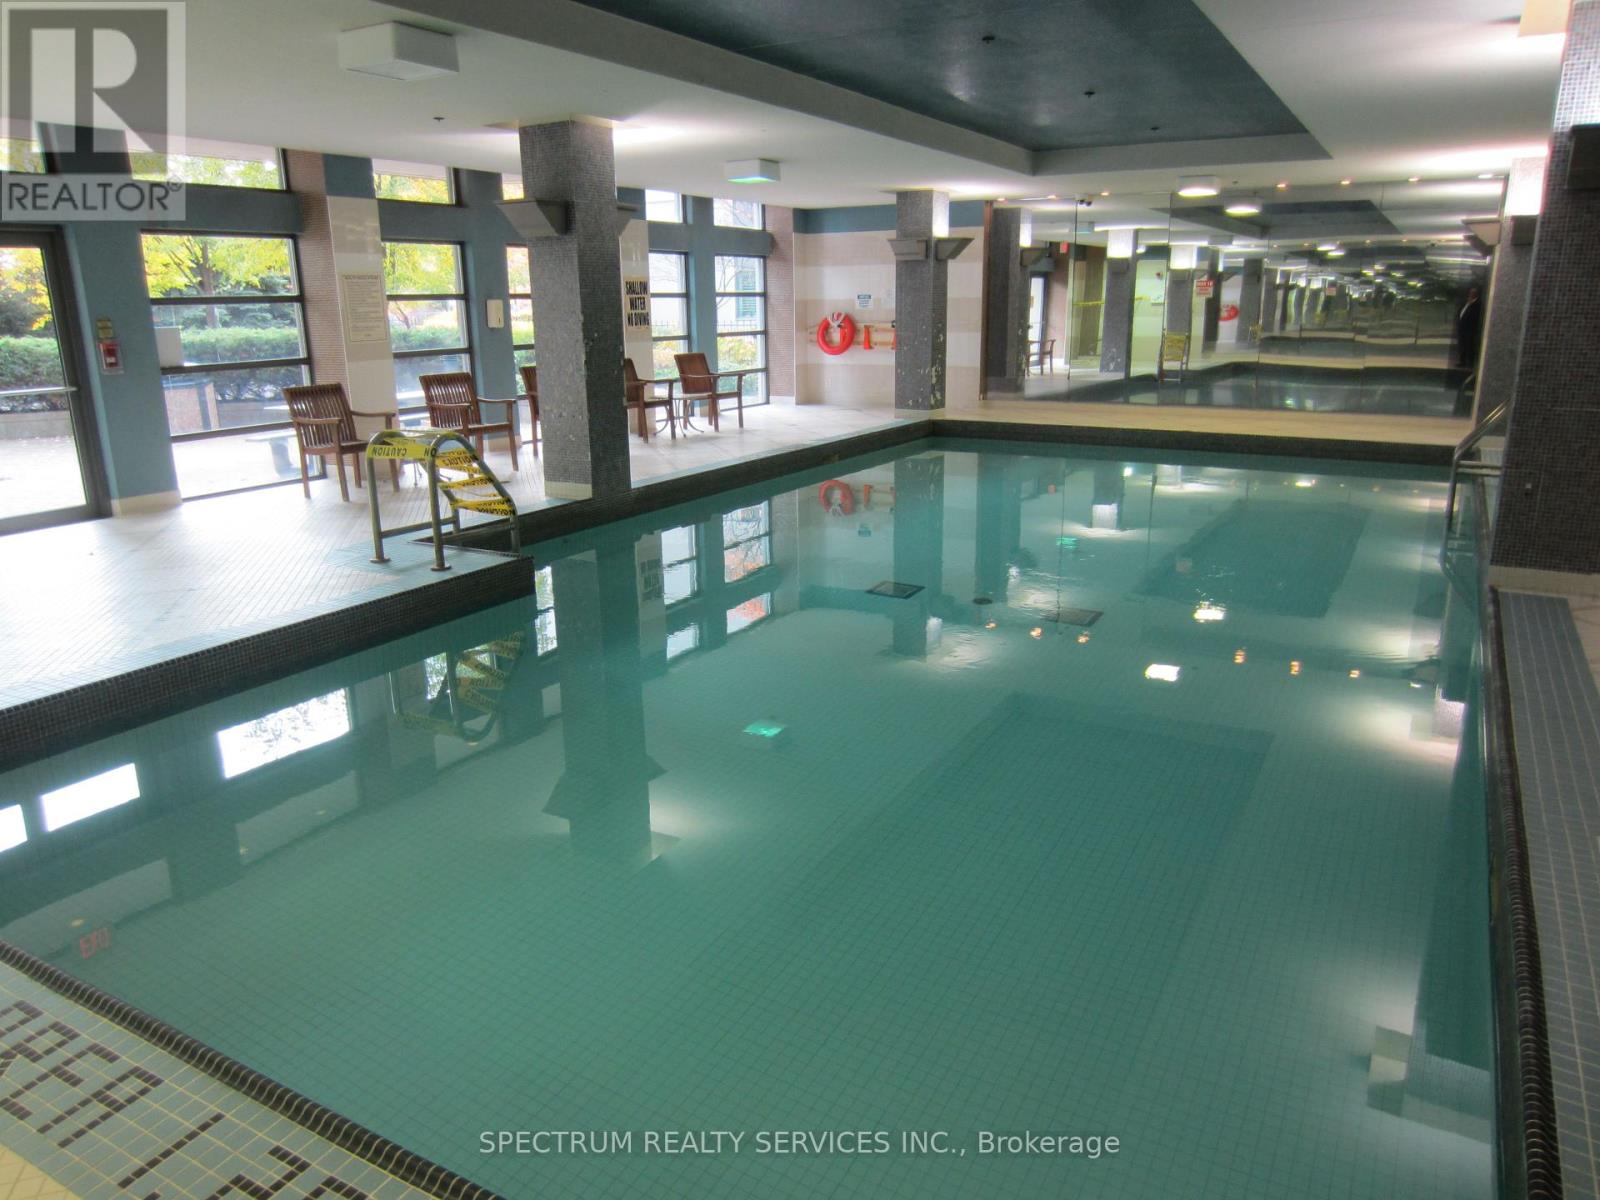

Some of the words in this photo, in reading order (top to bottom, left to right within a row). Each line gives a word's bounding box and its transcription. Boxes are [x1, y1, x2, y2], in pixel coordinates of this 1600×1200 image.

[625, 280, 648, 295] SHALLOW
[629, 296, 646, 311] WATER
[627, 312, 633, 326] NO
[634, 312, 650, 326] DIVING
[372, 446, 407, 457] CAUTION
